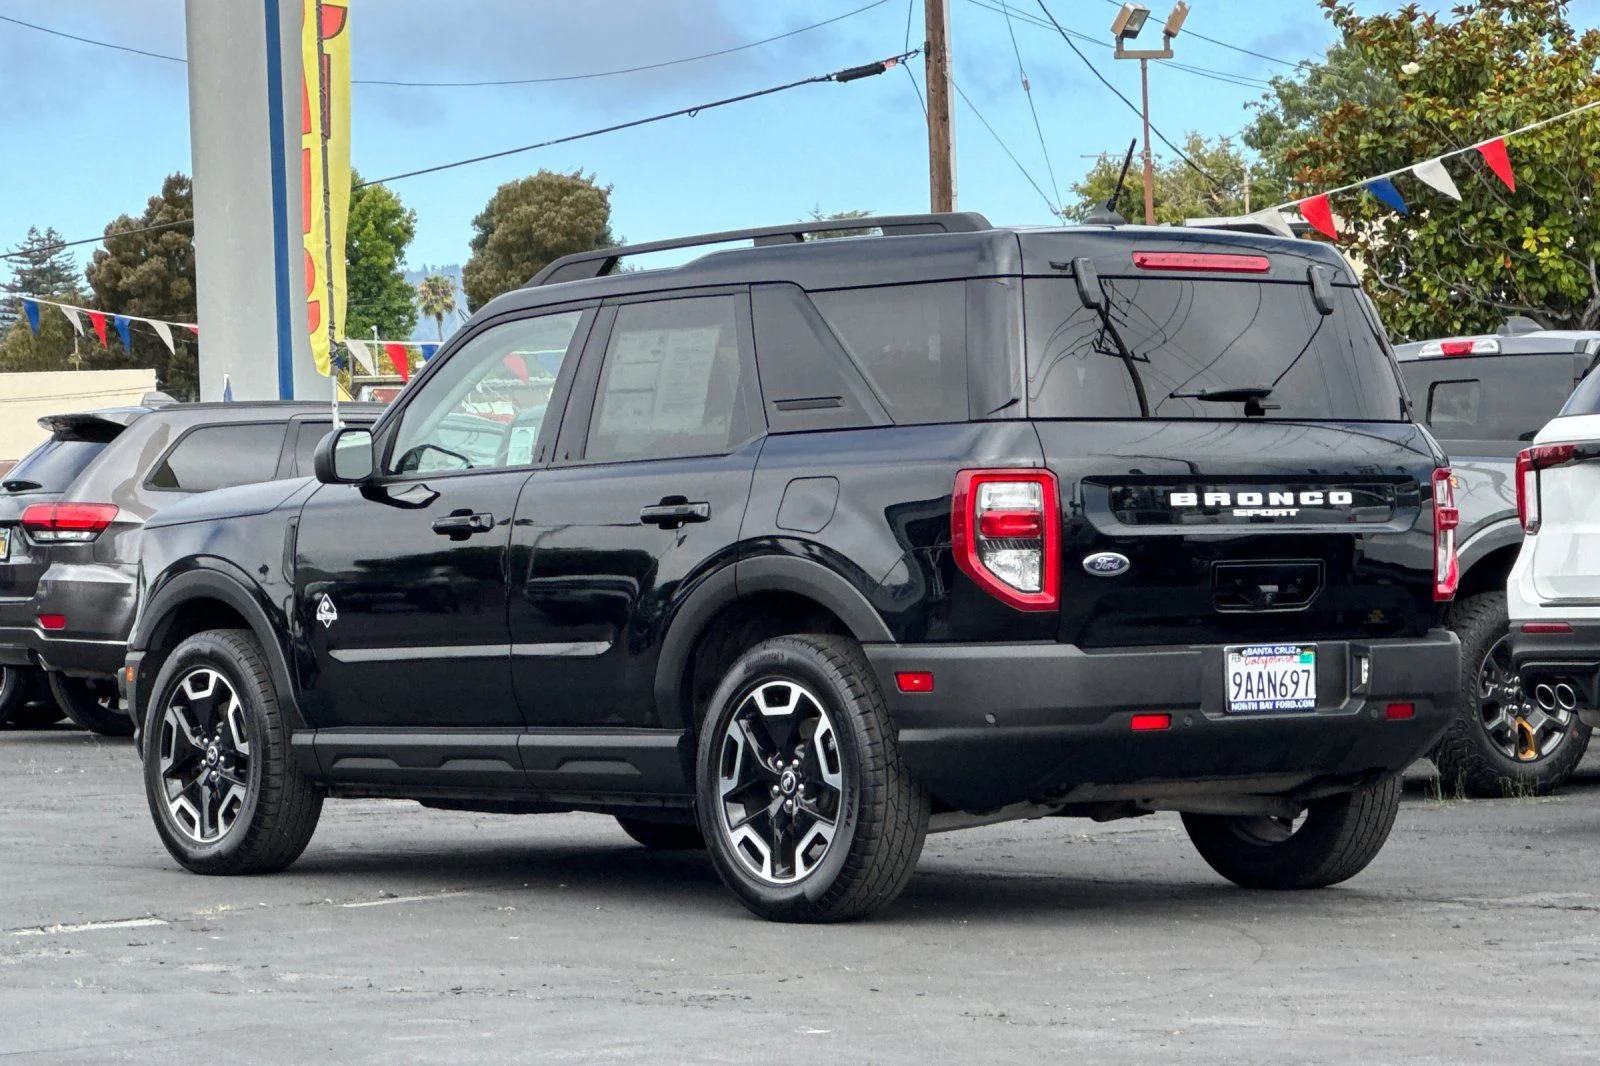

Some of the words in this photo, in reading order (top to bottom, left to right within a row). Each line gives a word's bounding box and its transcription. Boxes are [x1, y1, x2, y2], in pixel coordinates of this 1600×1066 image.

[1170, 492, 1353, 506] BRONCO
[1233, 509, 1299, 517] SPORT
[1247, 647, 1274, 656] SANTA
[1275, 646, 1296, 655] CRUZ
[1244, 655, 1294, 668] California
[1233, 670, 1310, 699] 9AAN697
[1231, 701, 1258, 711] NORTH
[1259, 700, 1274, 710] BAY
[1275, 699, 1315, 709] FORD.COM
